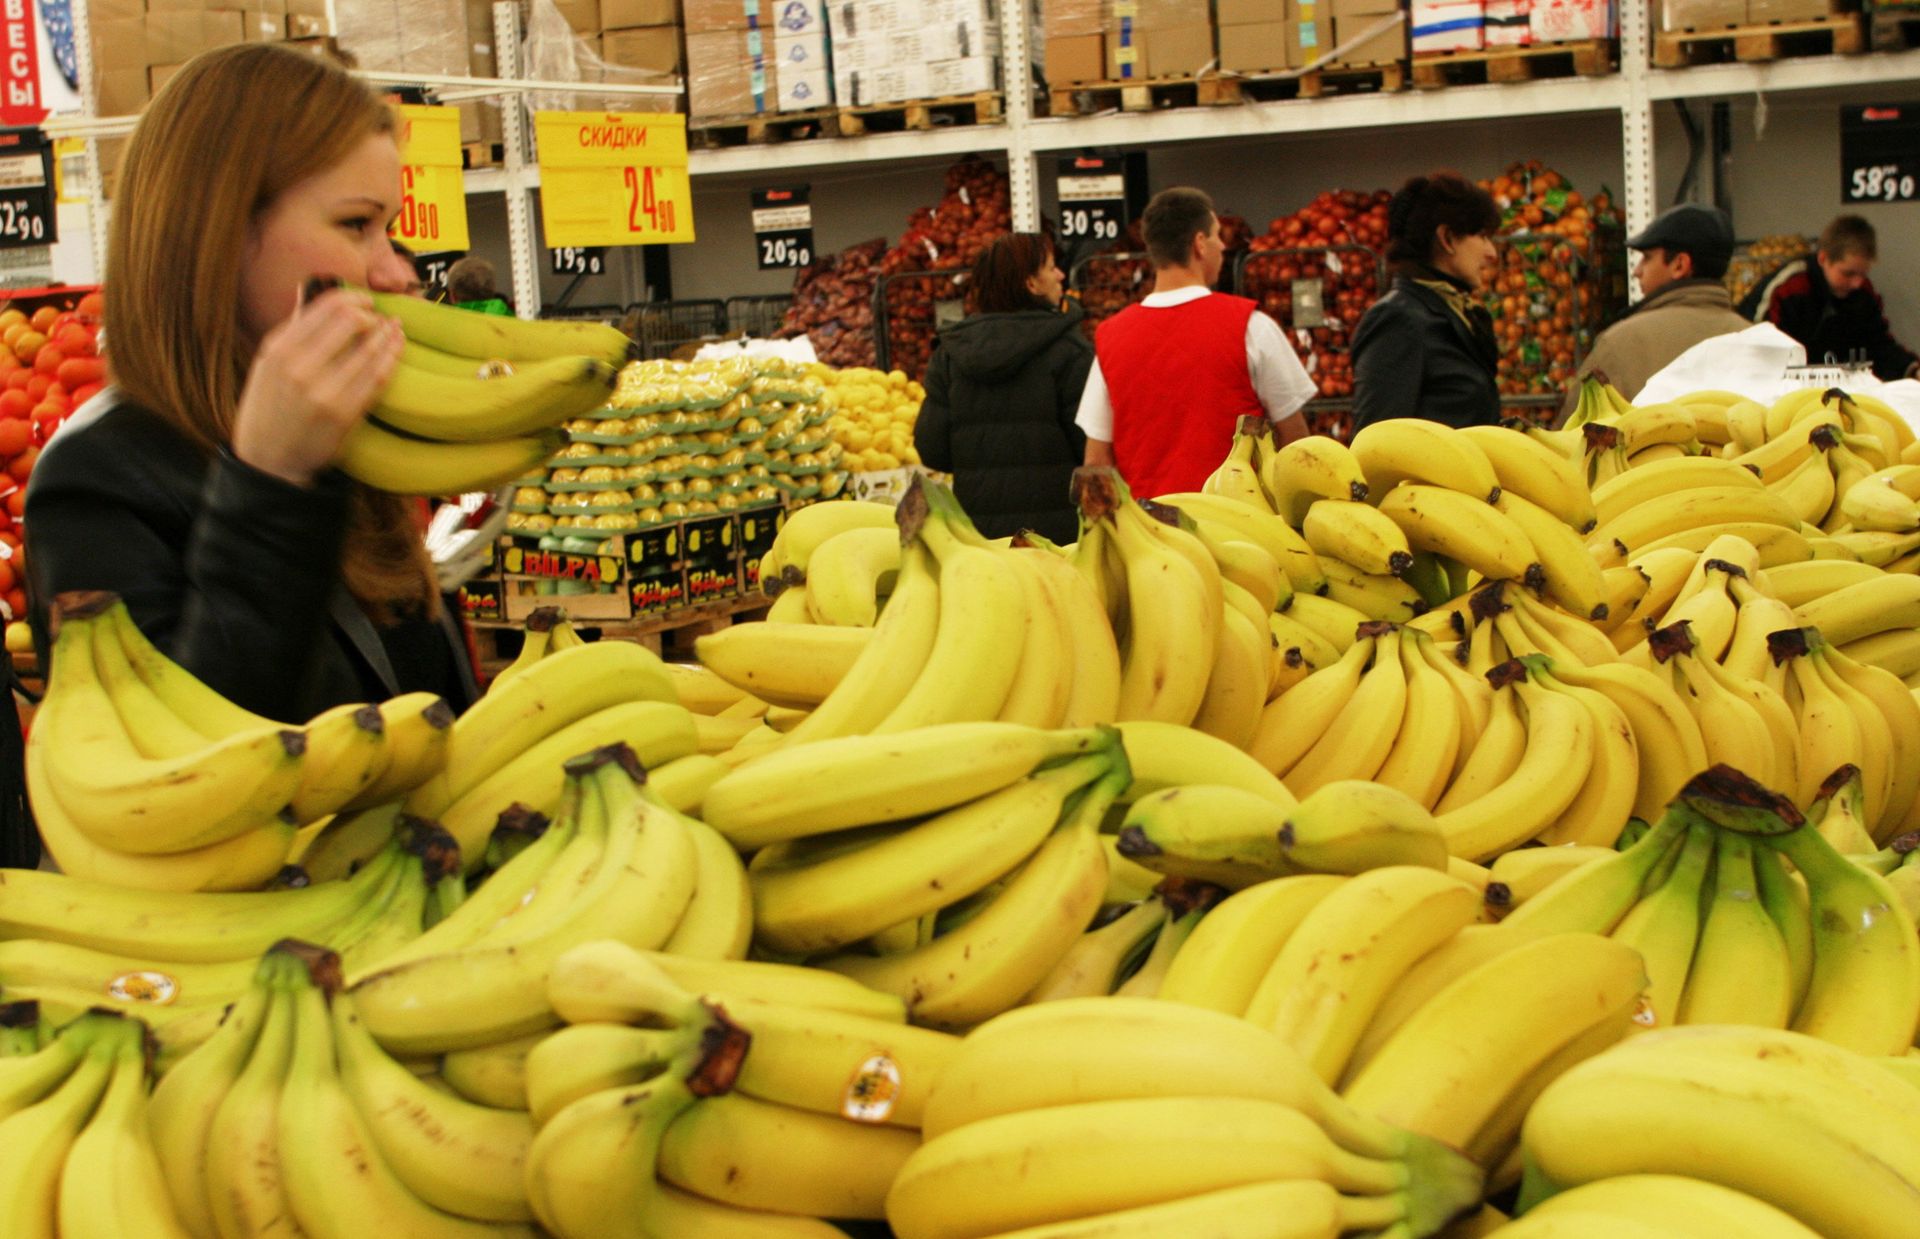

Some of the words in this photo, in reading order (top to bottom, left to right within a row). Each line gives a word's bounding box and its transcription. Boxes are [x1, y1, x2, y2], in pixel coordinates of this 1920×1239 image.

[5, 0, 35, 106] ВЕСЫ
[579, 126, 647, 149] СКИДКИ
[388, 165, 417, 238] 6
